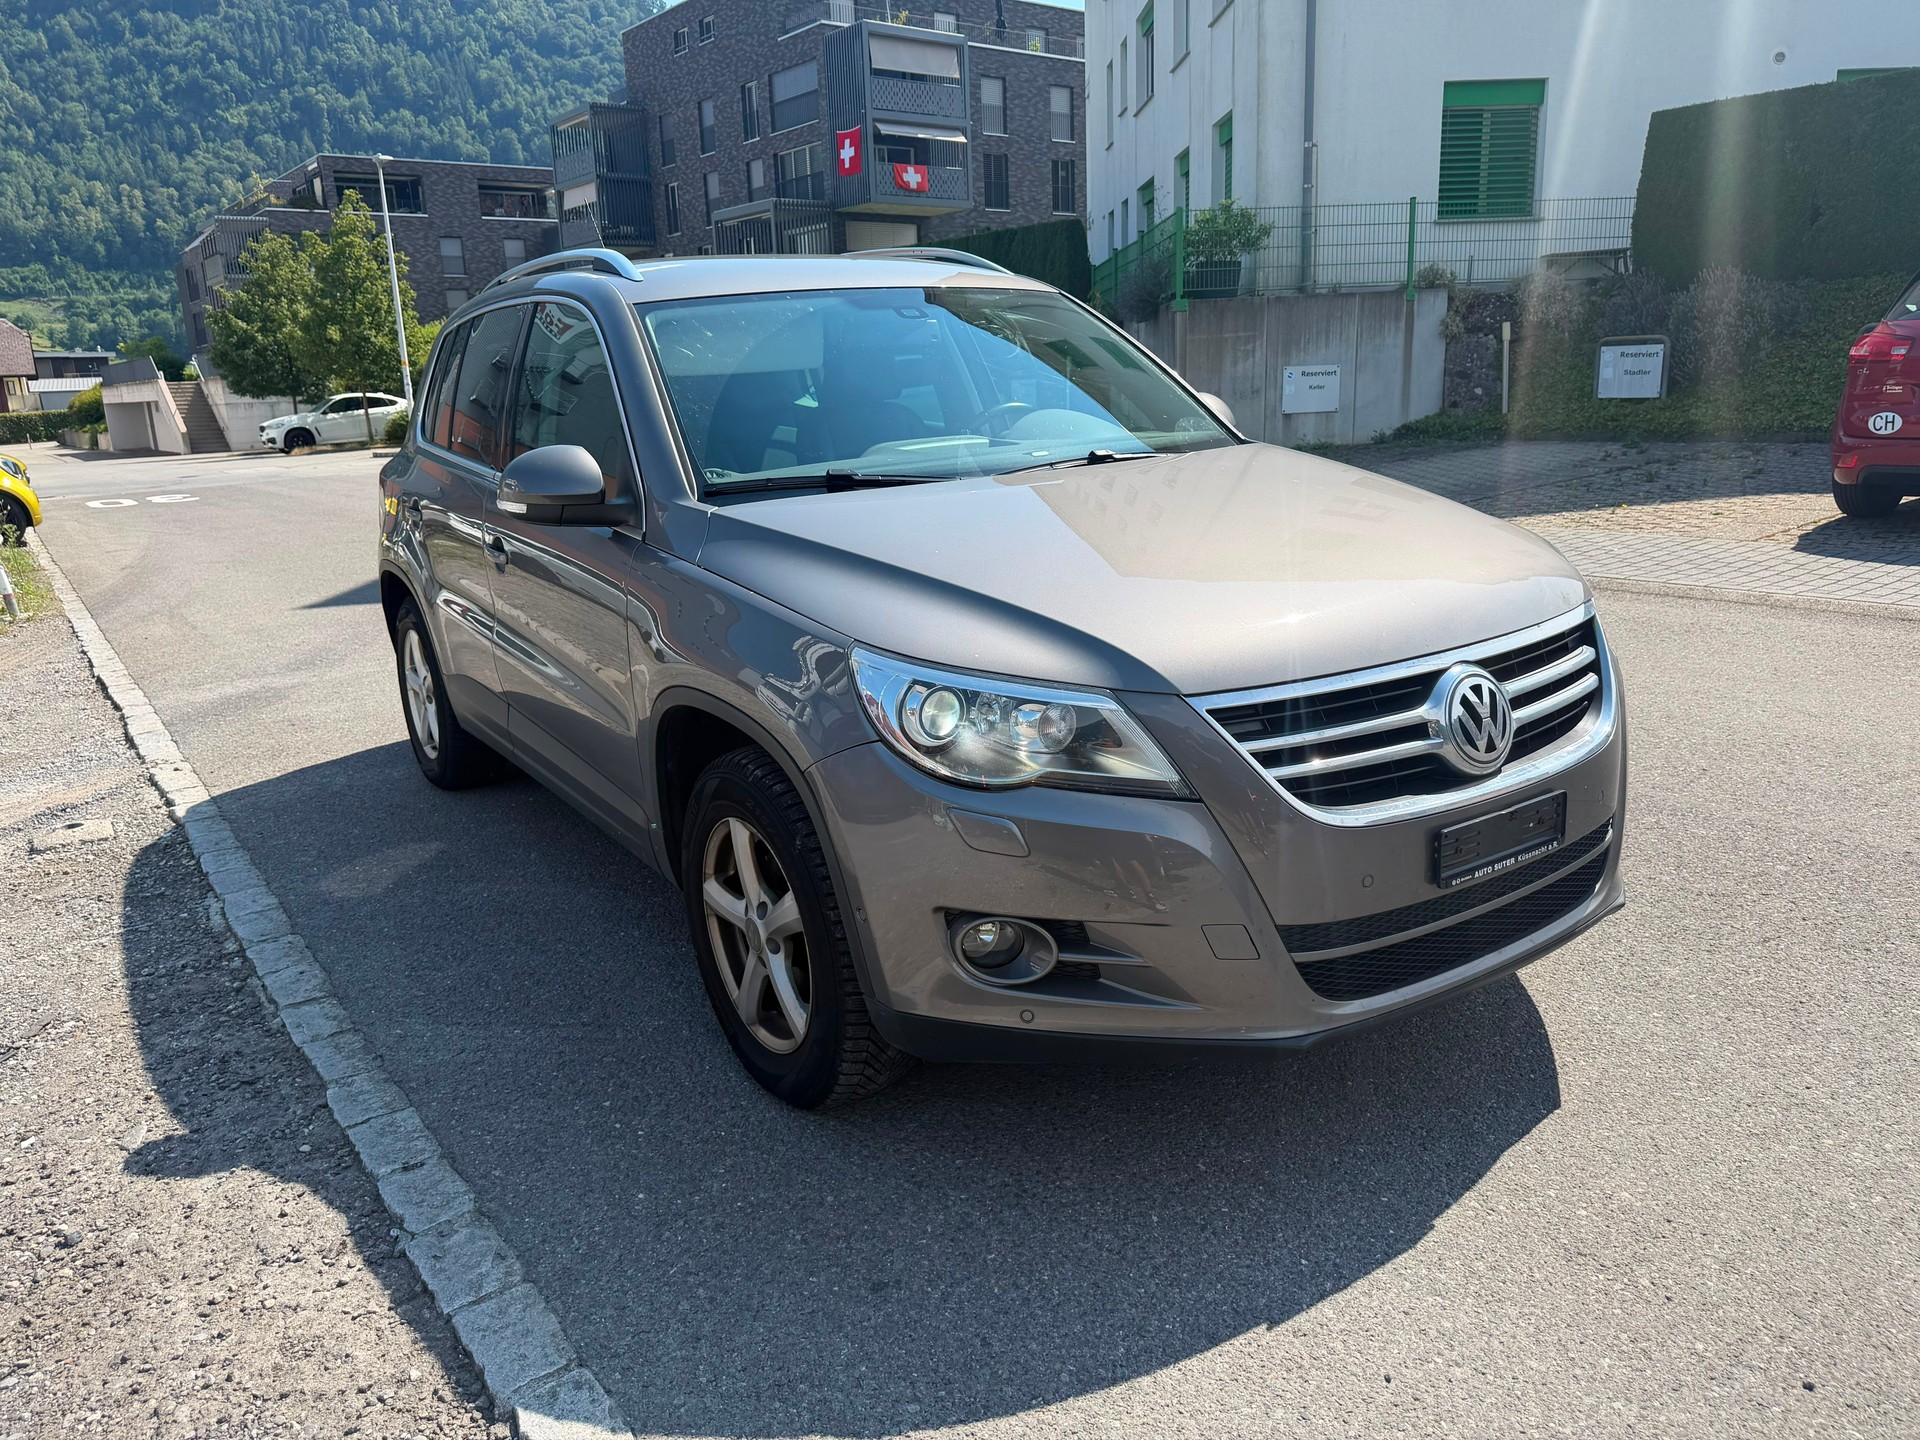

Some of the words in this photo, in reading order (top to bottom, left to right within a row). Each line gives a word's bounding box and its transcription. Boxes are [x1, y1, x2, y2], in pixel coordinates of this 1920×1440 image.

[1620, 350, 1659, 358] Reserviert
[1872, 414, 1895, 432] CH
[1450, 674, 1508, 763] VW
[1474, 866, 1493, 878] AUTO
[1494, 857, 1516, 871] SUTER
[1517, 846, 1547, 862] Küssnacht
